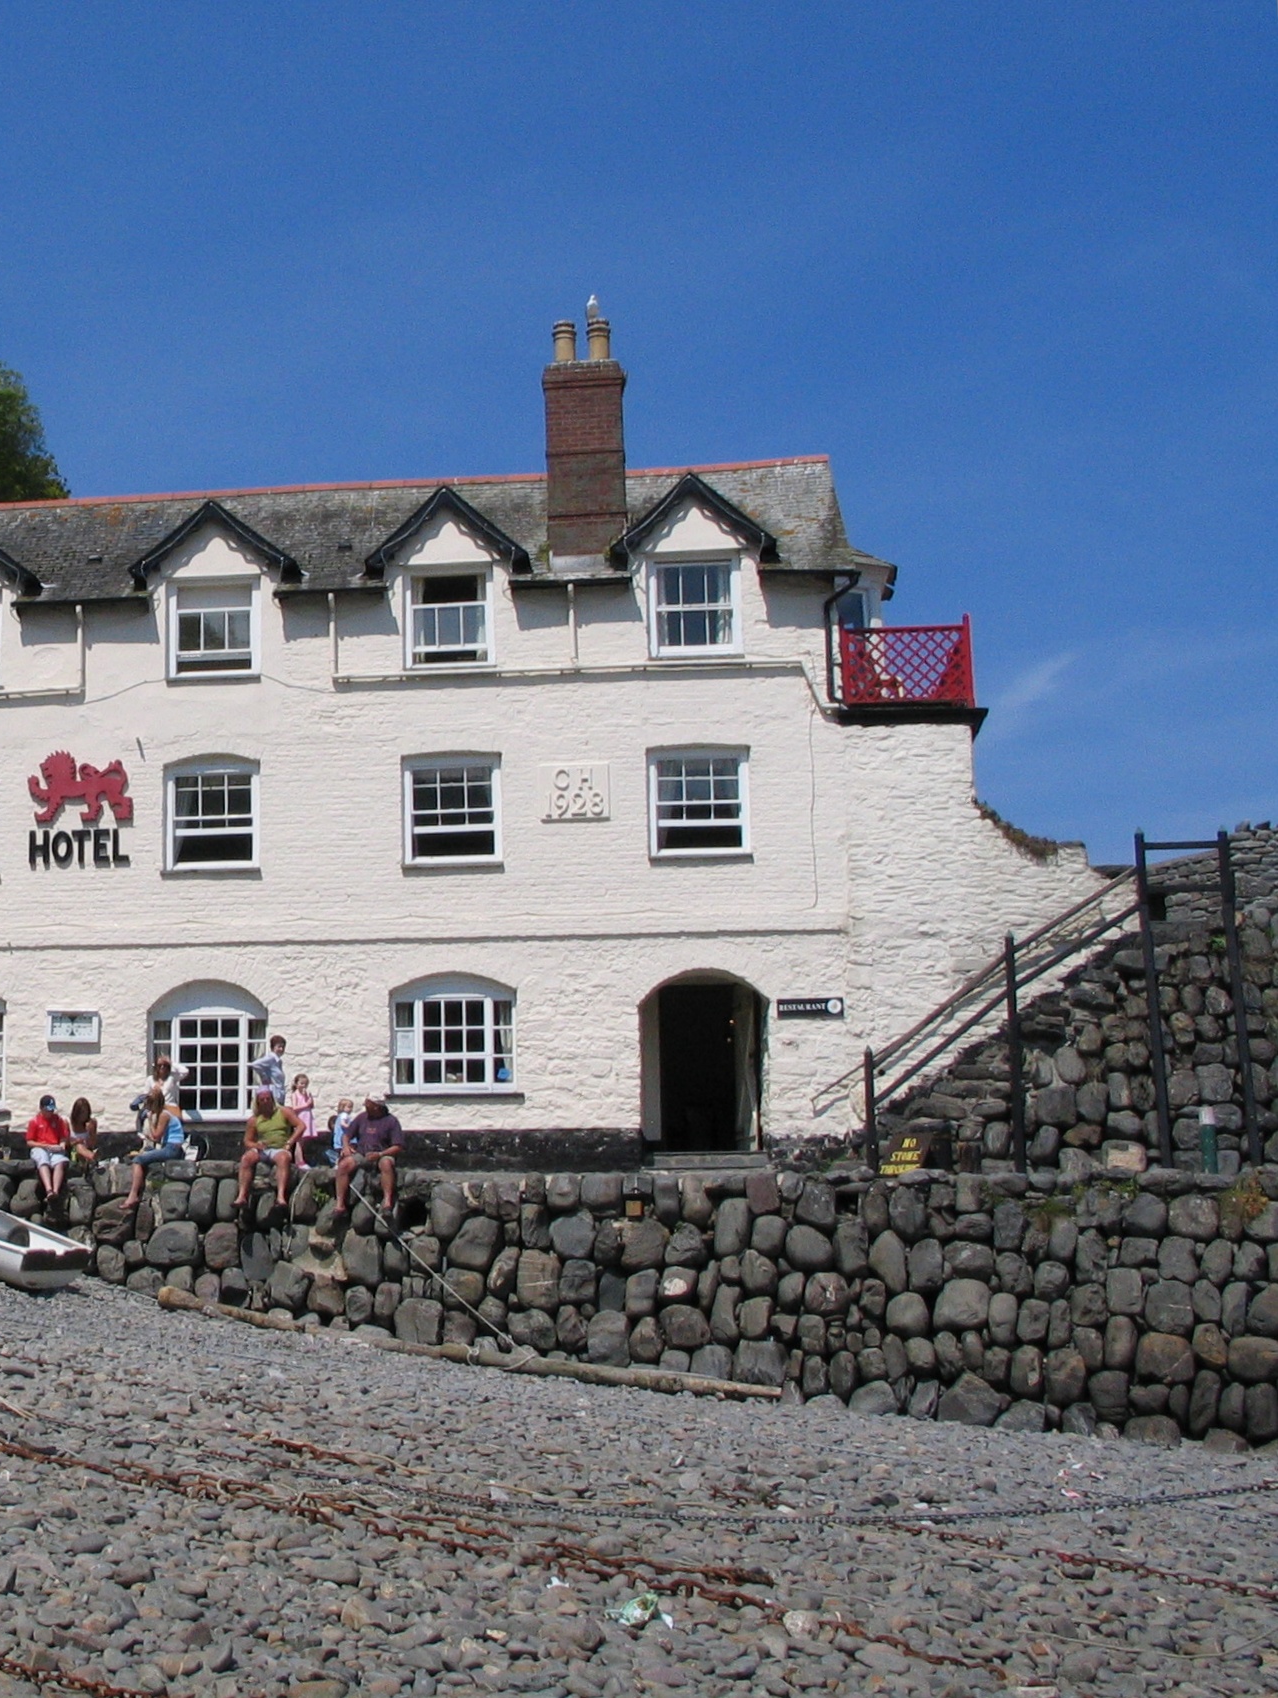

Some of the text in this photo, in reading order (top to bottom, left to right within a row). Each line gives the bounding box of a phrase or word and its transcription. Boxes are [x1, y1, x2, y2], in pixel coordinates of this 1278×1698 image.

[544, 792, 604, 819] 1928
[28, 828, 130, 868] HOTEL
[778, 1002, 826, 1012] RESTAURANT
[901, 1137, 917, 1149] NO
[890, 1150, 921, 1161] STONE
